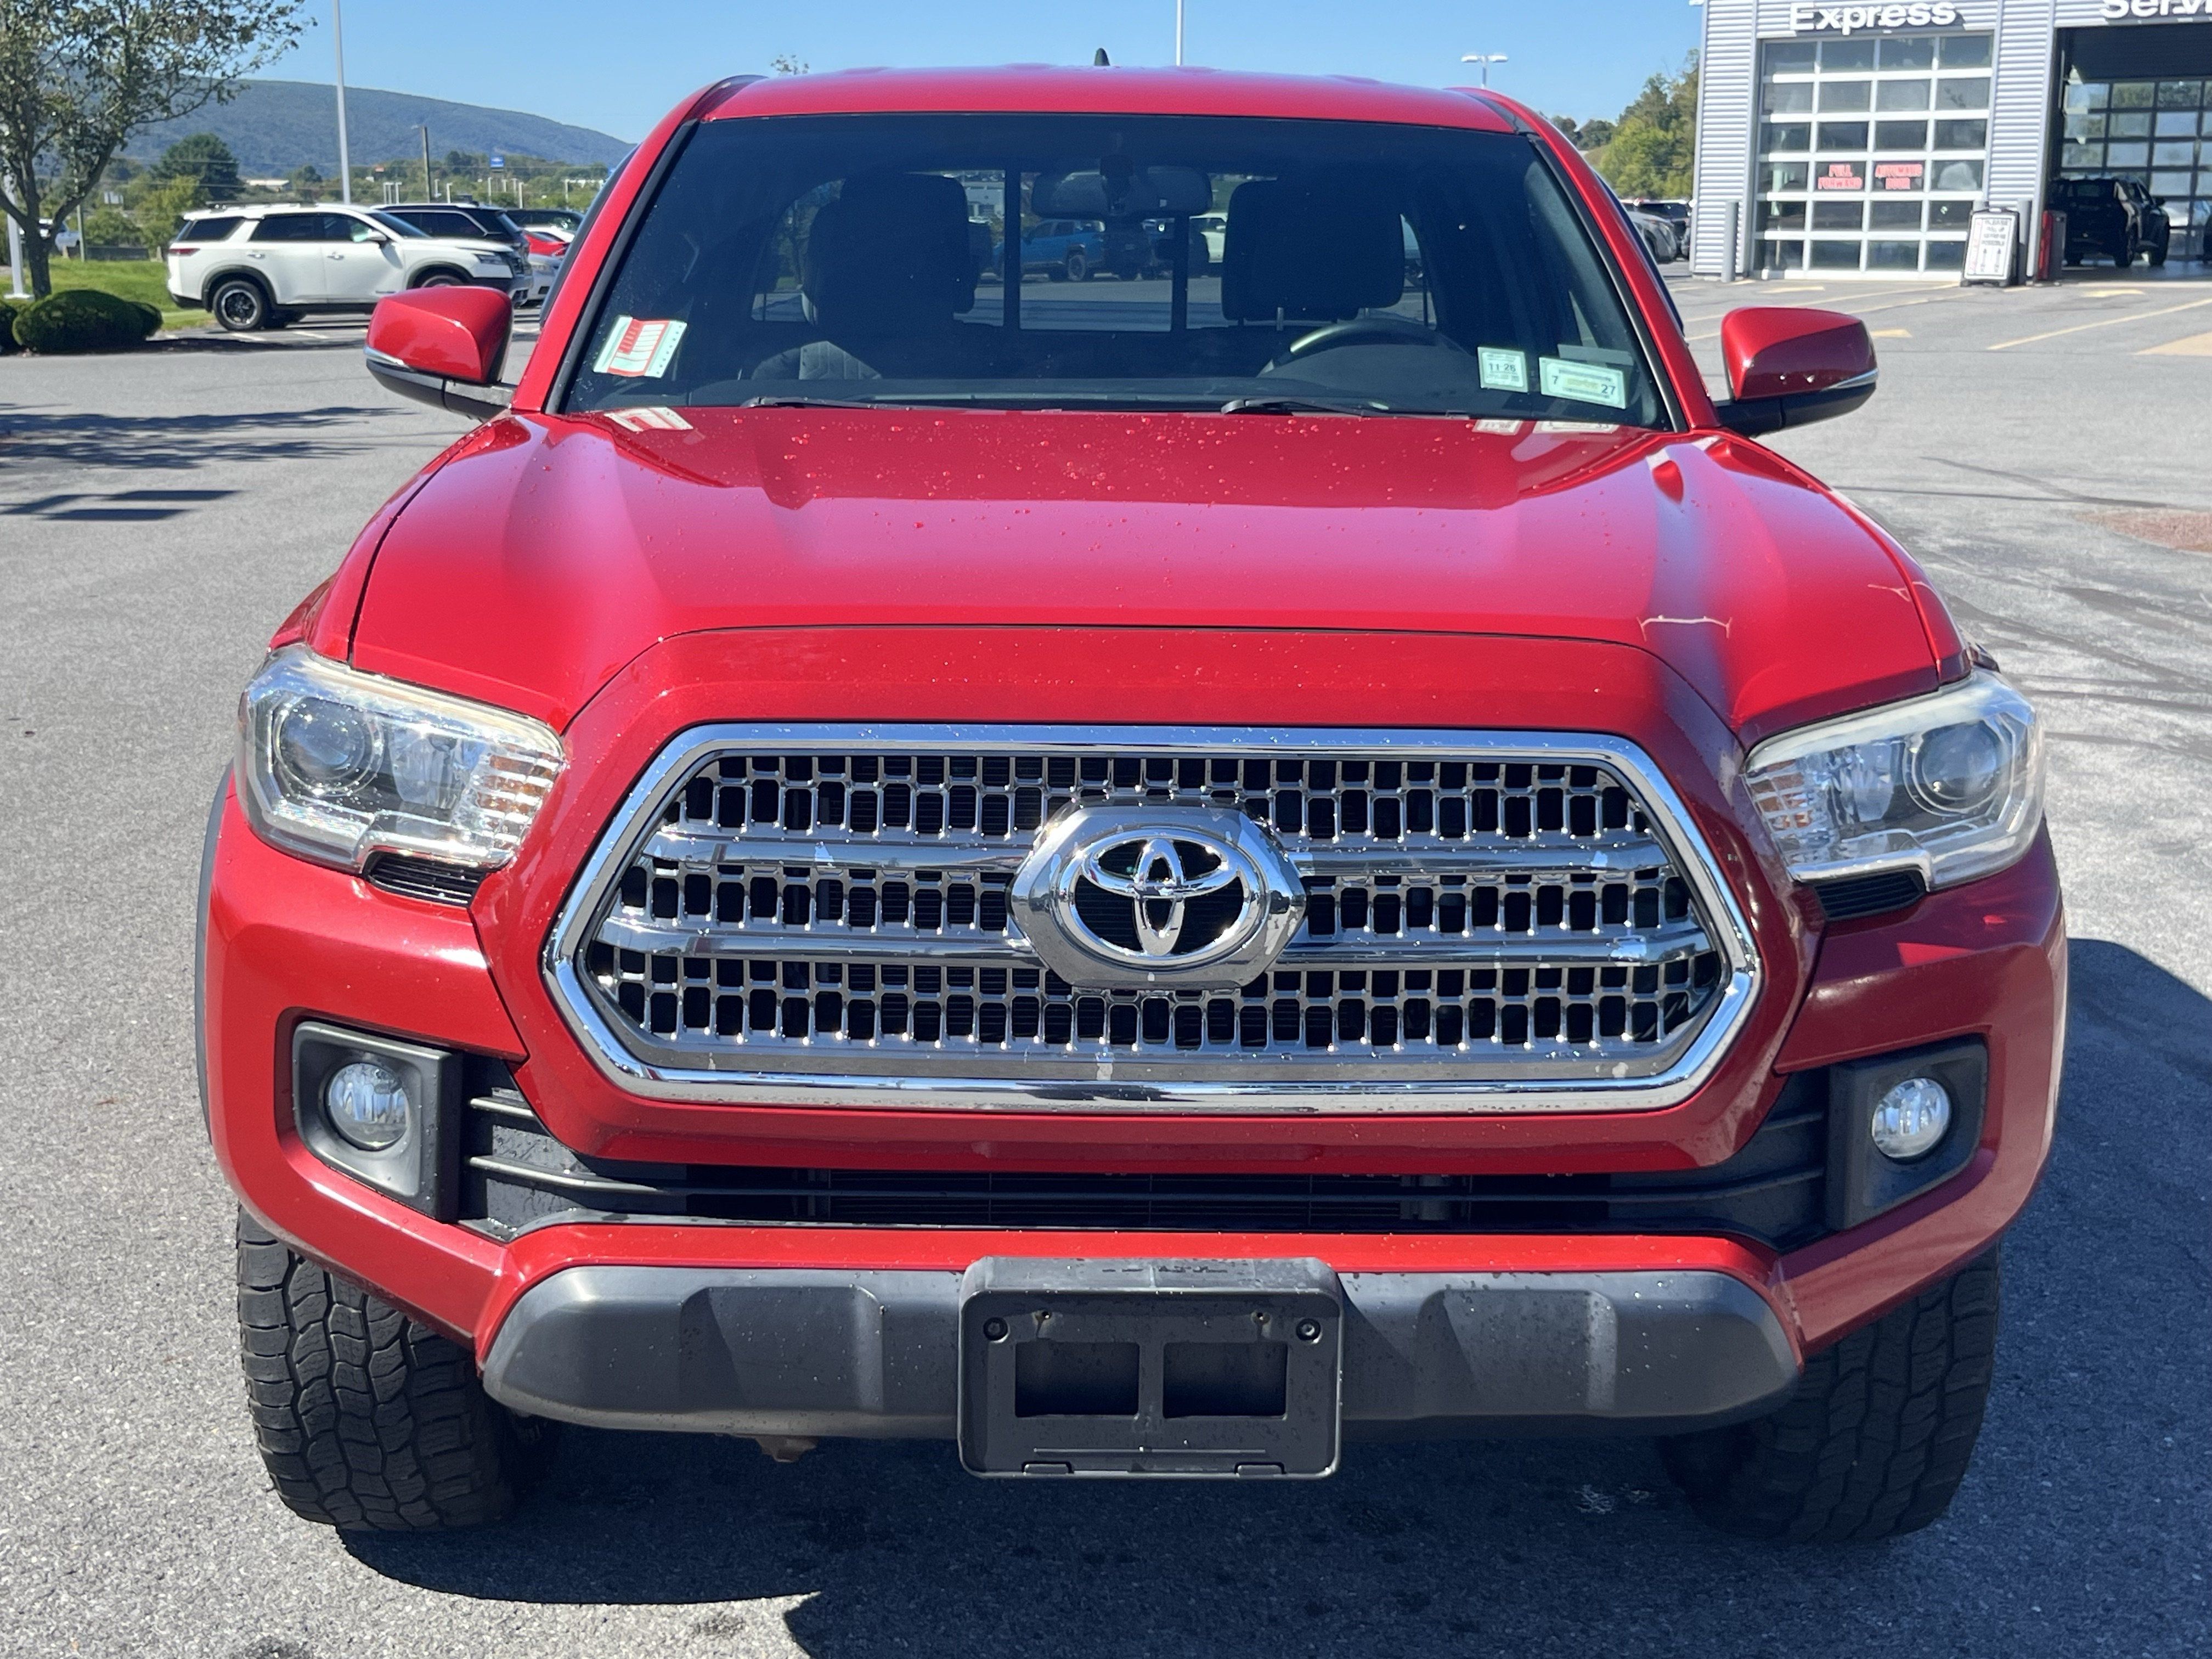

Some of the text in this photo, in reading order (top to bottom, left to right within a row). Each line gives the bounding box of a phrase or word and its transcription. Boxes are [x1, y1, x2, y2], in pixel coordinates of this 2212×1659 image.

[1790, 2, 1956, 35] Express
[1552, 375, 1559, 385] 7
[1601, 384, 1616, 395] 27
